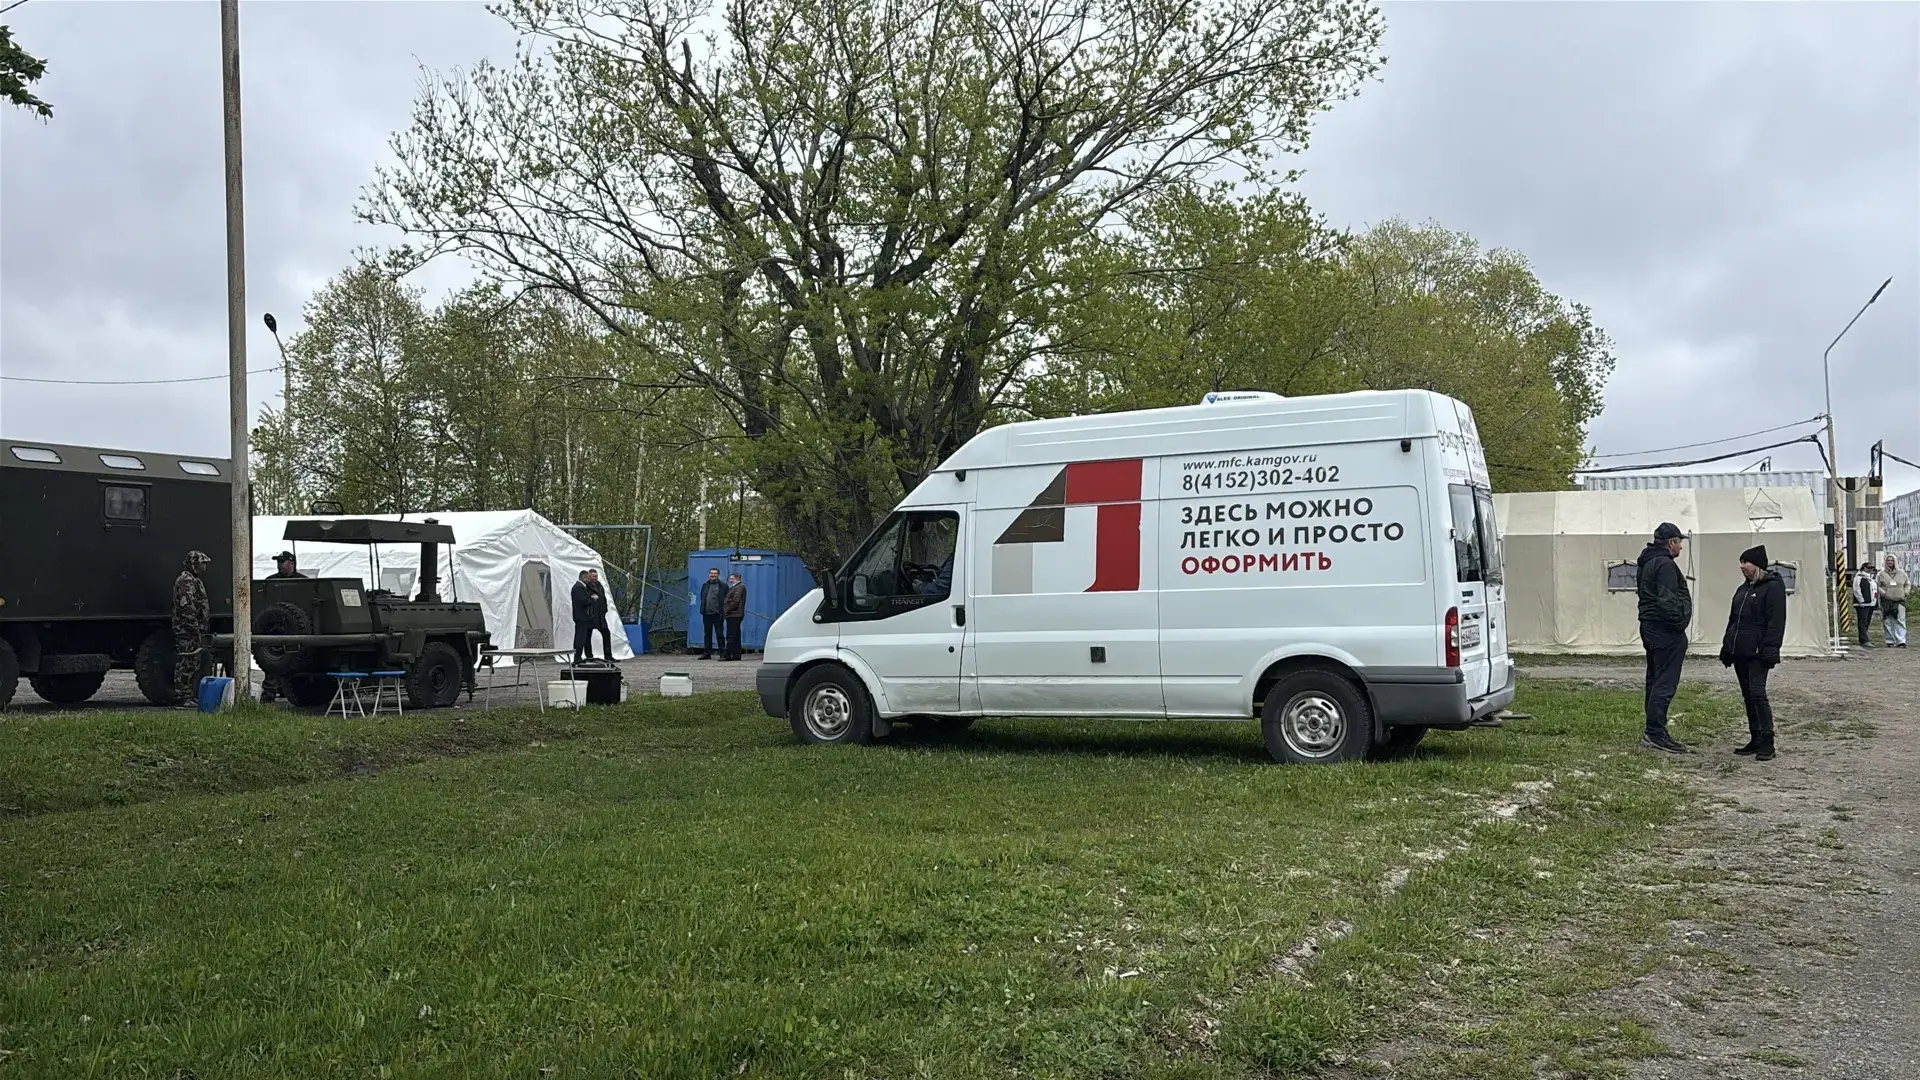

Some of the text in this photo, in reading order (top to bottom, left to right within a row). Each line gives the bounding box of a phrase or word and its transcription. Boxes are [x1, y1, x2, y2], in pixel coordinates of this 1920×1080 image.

[1183, 454, 1317, 471] www.mfc.kamgov.ru
[1182, 465, 1340, 494] 8(4152)302-402
[1181, 497, 1373, 526] ЗДЕСЬ МОЖНО
[1180, 522, 1404, 549] ЛЕГКО И ПРОСТО
[1181, 551, 1332, 575] ОФОРМИТЬ
